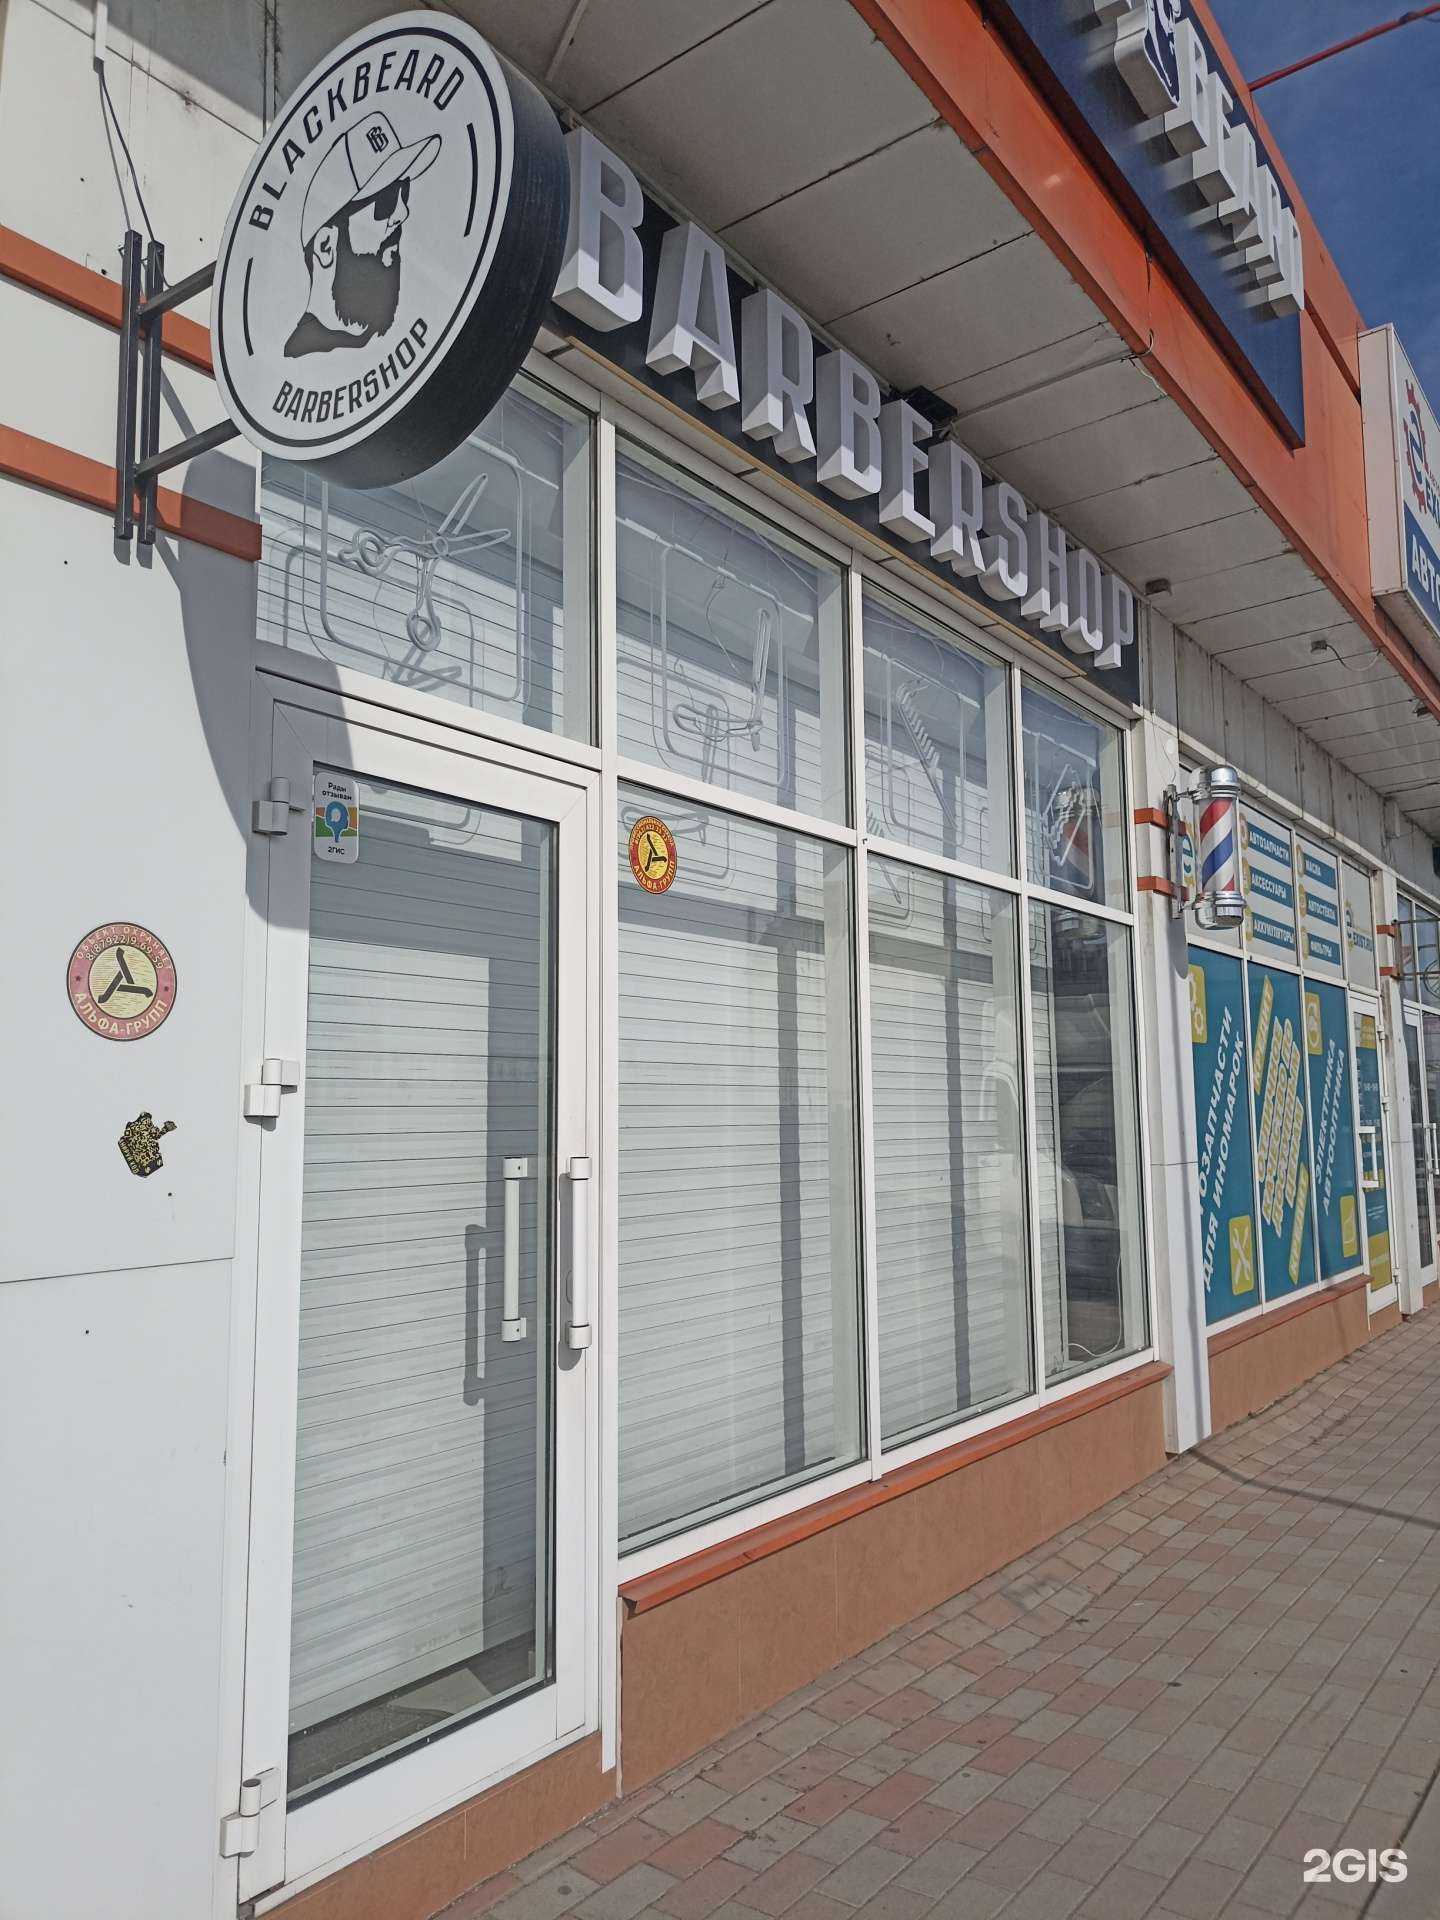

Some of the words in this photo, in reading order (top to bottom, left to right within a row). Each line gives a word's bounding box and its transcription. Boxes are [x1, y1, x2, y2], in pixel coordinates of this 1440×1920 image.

[249, 49, 465, 231] BLACKBEARD
[272, 317, 428, 423] BARBERSHOP
[562, 126, 1134, 669] BARBERSHOP
[327, 846, 345, 855] 2ГИС
[633, 860, 675, 890] АЛЬФА-ГРУПП
[75, 992, 168, 1035] АЛЬФА-ГРУПП
[1213, 1032, 1244, 1209] ИНОМАРОК
[1316, 1039, 1336, 1185] ЭЛЕКТРИКА
